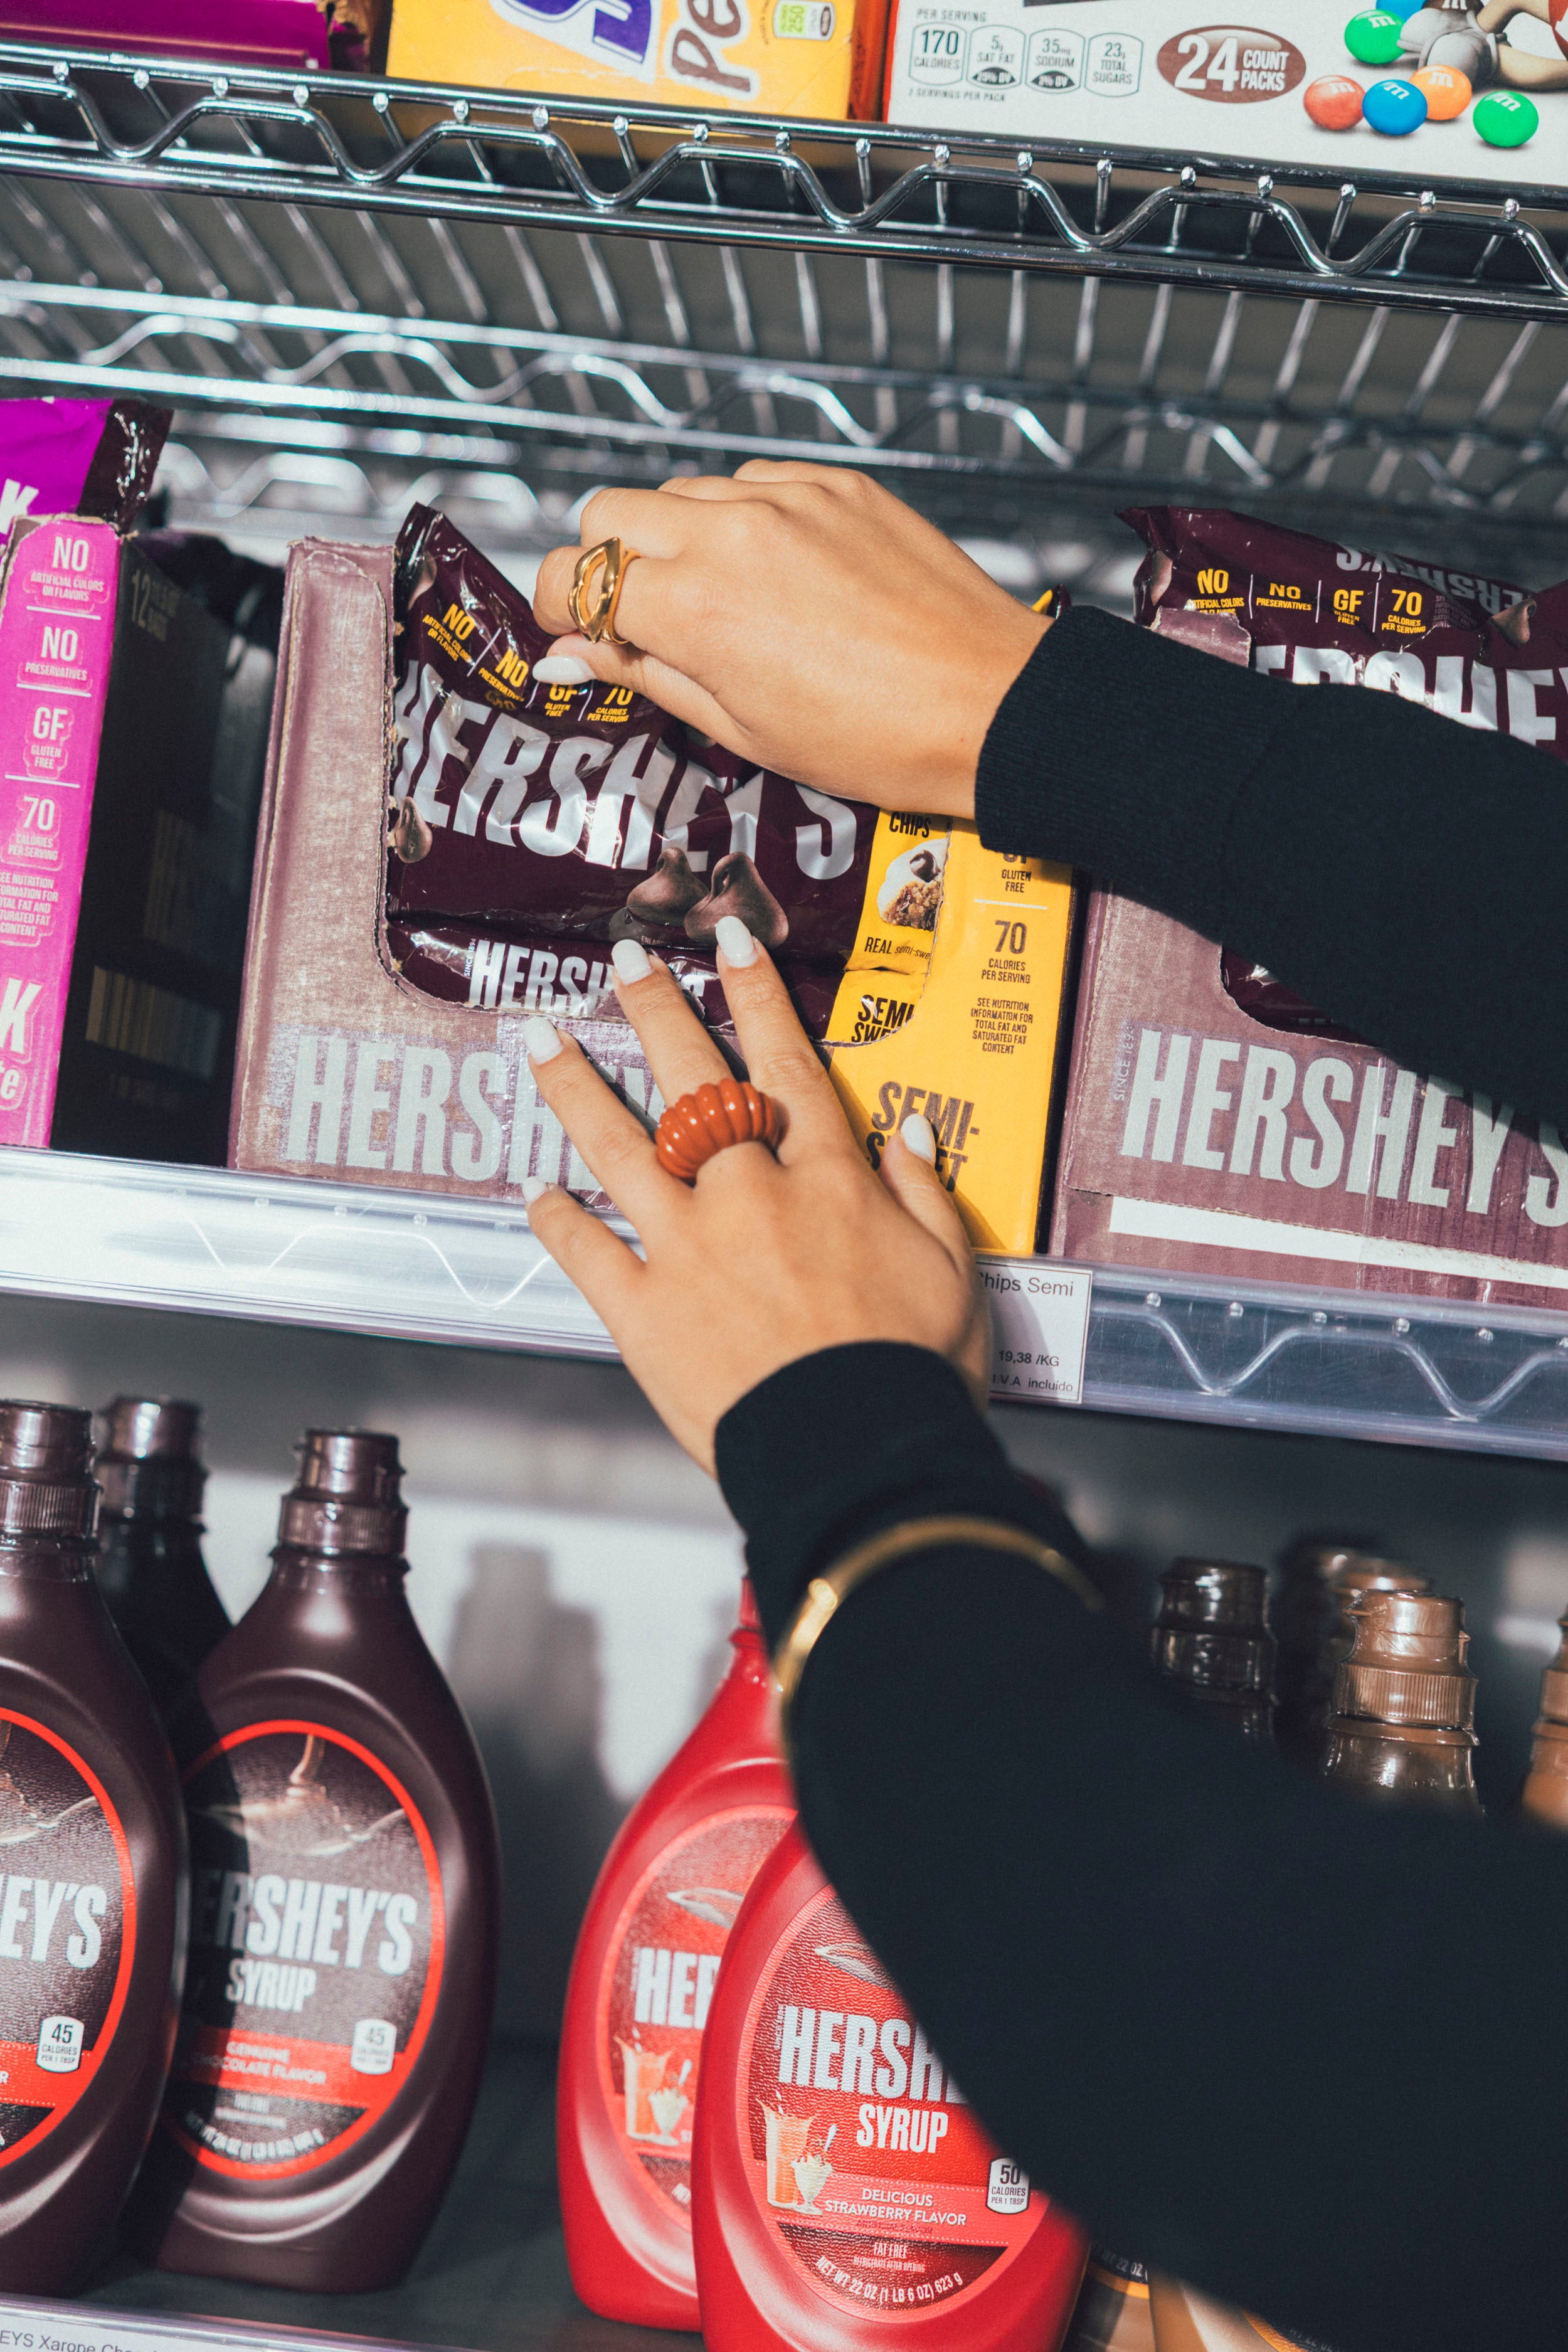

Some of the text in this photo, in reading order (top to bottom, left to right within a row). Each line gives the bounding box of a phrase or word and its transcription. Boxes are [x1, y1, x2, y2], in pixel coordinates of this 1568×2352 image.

[916, 9, 987, 22] PER SERVING
[1370, 14, 1396, 29] m
[921, 30, 960, 55] 170
[913, 56, 961, 70] CALORIES
[977, 53, 1015, 65] SAT FAT
[1036, 55, 1074, 68] SODIUM
[1101, 60, 1127, 72] TOTAL
[1174, 33, 1239, 92] 24
[1242, 49, 1290, 70] COUNT
[1093, 72, 1133, 85] SUGARS
[1241, 72, 1286, 92] PACKS
[1428, 71, 1453, 88] m
[1382, 82, 1405, 100] m
[1496, 95, 1521, 113] m
[52, 536, 89, 571] NO
[30, 571, 105, 593] ARTIFICIAL COLORS
[1197, 568, 1229, 595] NO
[42, 585, 90, 602] OR FLAVORS
[1269, 583, 1301, 600] NO
[1221, 597, 1245, 608] COLORS
[1256, 597, 1312, 611] PRESERVATIVES
[1333, 589, 1364, 613] GF
[1391, 589, 1422, 616] 70
[442, 603, 476, 640] NO
[1337, 615, 1355, 625] FREE
[1381, 622, 1426, 635] PER SERVING
[1387, 614, 1422, 627] CALORIES
[40, 625, 78, 662] NO
[421, 614, 473, 664] ARTIFICIAL COLORS
[427, 628, 460, 662] OR FLAVORS
[24, 662, 88, 681] PRESERVATIVES
[494, 646, 529, 688] NO
[544, 702, 571, 711] GLUTEN
[595, 707, 628, 716] CALORIES
[33, 706, 68, 741] GF
[586, 712, 629, 723] PER SERVING
[31, 744, 62, 758] GLUTEN
[34, 756, 55, 770] FREE
[23, 795, 55, 831] 70
[889, 811, 931, 838] CHIPS
[16, 833, 53, 848] CALORIES
[8, 844, 60, 862] PER SERVING
[13, 874, 55, 889] NUTRITION
[1002, 869, 1032, 881] GLUTEN
[1005, 881, 1025, 893] FREE
[41, 890, 59, 903] FOR
[18, 899, 51, 914] FAT AND
[35, 914, 51, 926] FAT
[0, 921, 37, 937] CONTENT
[995, 919, 1027, 955] 70
[864, 936, 892, 954] REAL
[464, 938, 477, 977] SINCE 1894
[988, 958, 1027, 971] CALORIES
[981, 969, 1030, 984] PER SERVING
[977, 997, 1029, 1012] SEE NUTRITION
[970, 1008, 1034, 1024] INFORMATION FOR
[975, 1019, 1027, 1034] TOTAL FAT AND
[972, 1030, 1027, 1044] SATURATED FAT
[982, 1042, 1015, 1055] CONTENT
[1114, 1061, 1131, 1101] SINCE
[1120, 1027, 1568, 1228] HERSHEYS
[1027, 1277, 1074, 1297] Semi
[999, 1350, 1060, 1367] 19,38 /KG
[993, 1373, 1021, 1387] I.V.A
[225, 1957, 317, 2013] SYRUP
[51, 2023, 74, 2044] 45
[41, 2043, 78, 2056] CALORIES
[856, 2103, 949, 2154] SYRUP
[1000, 2164, 1021, 2185] 50
[862, 2188, 933, 2207] DELICIOUS
[991, 2186, 1026, 2196] CALORIES
[824, 2200, 967, 2227] STRAWBERRY FLAVOR
[873, 2242, 909, 2259] FAT FREE
[853, 2256, 926, 2273] REFRIGERATE AFTER OPENING
[815, 2255, 964, 2304] NET WT 22 OZ (1 LB 6 OZ) 623 g
[0, 2329, 34, 2348] EYS
